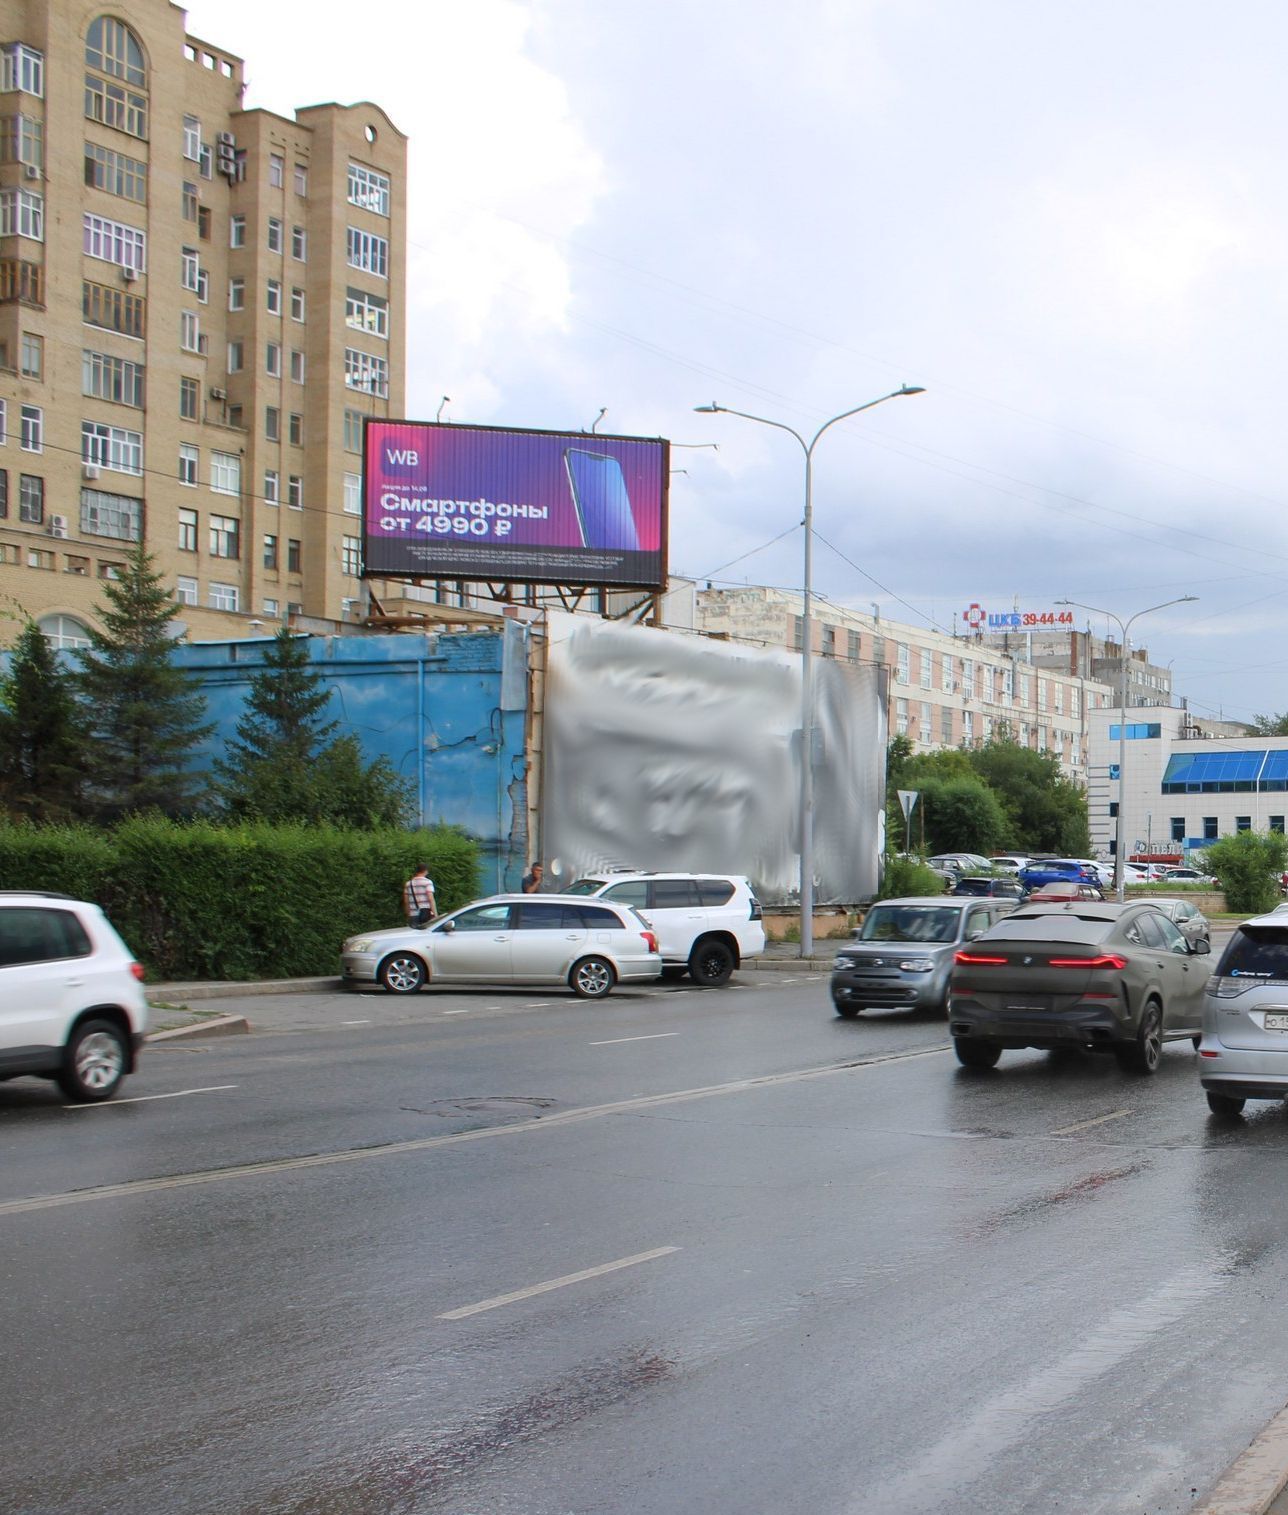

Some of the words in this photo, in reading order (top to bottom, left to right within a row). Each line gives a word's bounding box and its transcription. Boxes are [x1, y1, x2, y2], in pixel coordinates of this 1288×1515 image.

[387, 449, 418, 466] WB
[380, 493, 548, 519] Смартфоны
[380, 517, 411, 532] от
[415, 515, 489, 536] 4990
[495, 519, 512, 537] ₽
